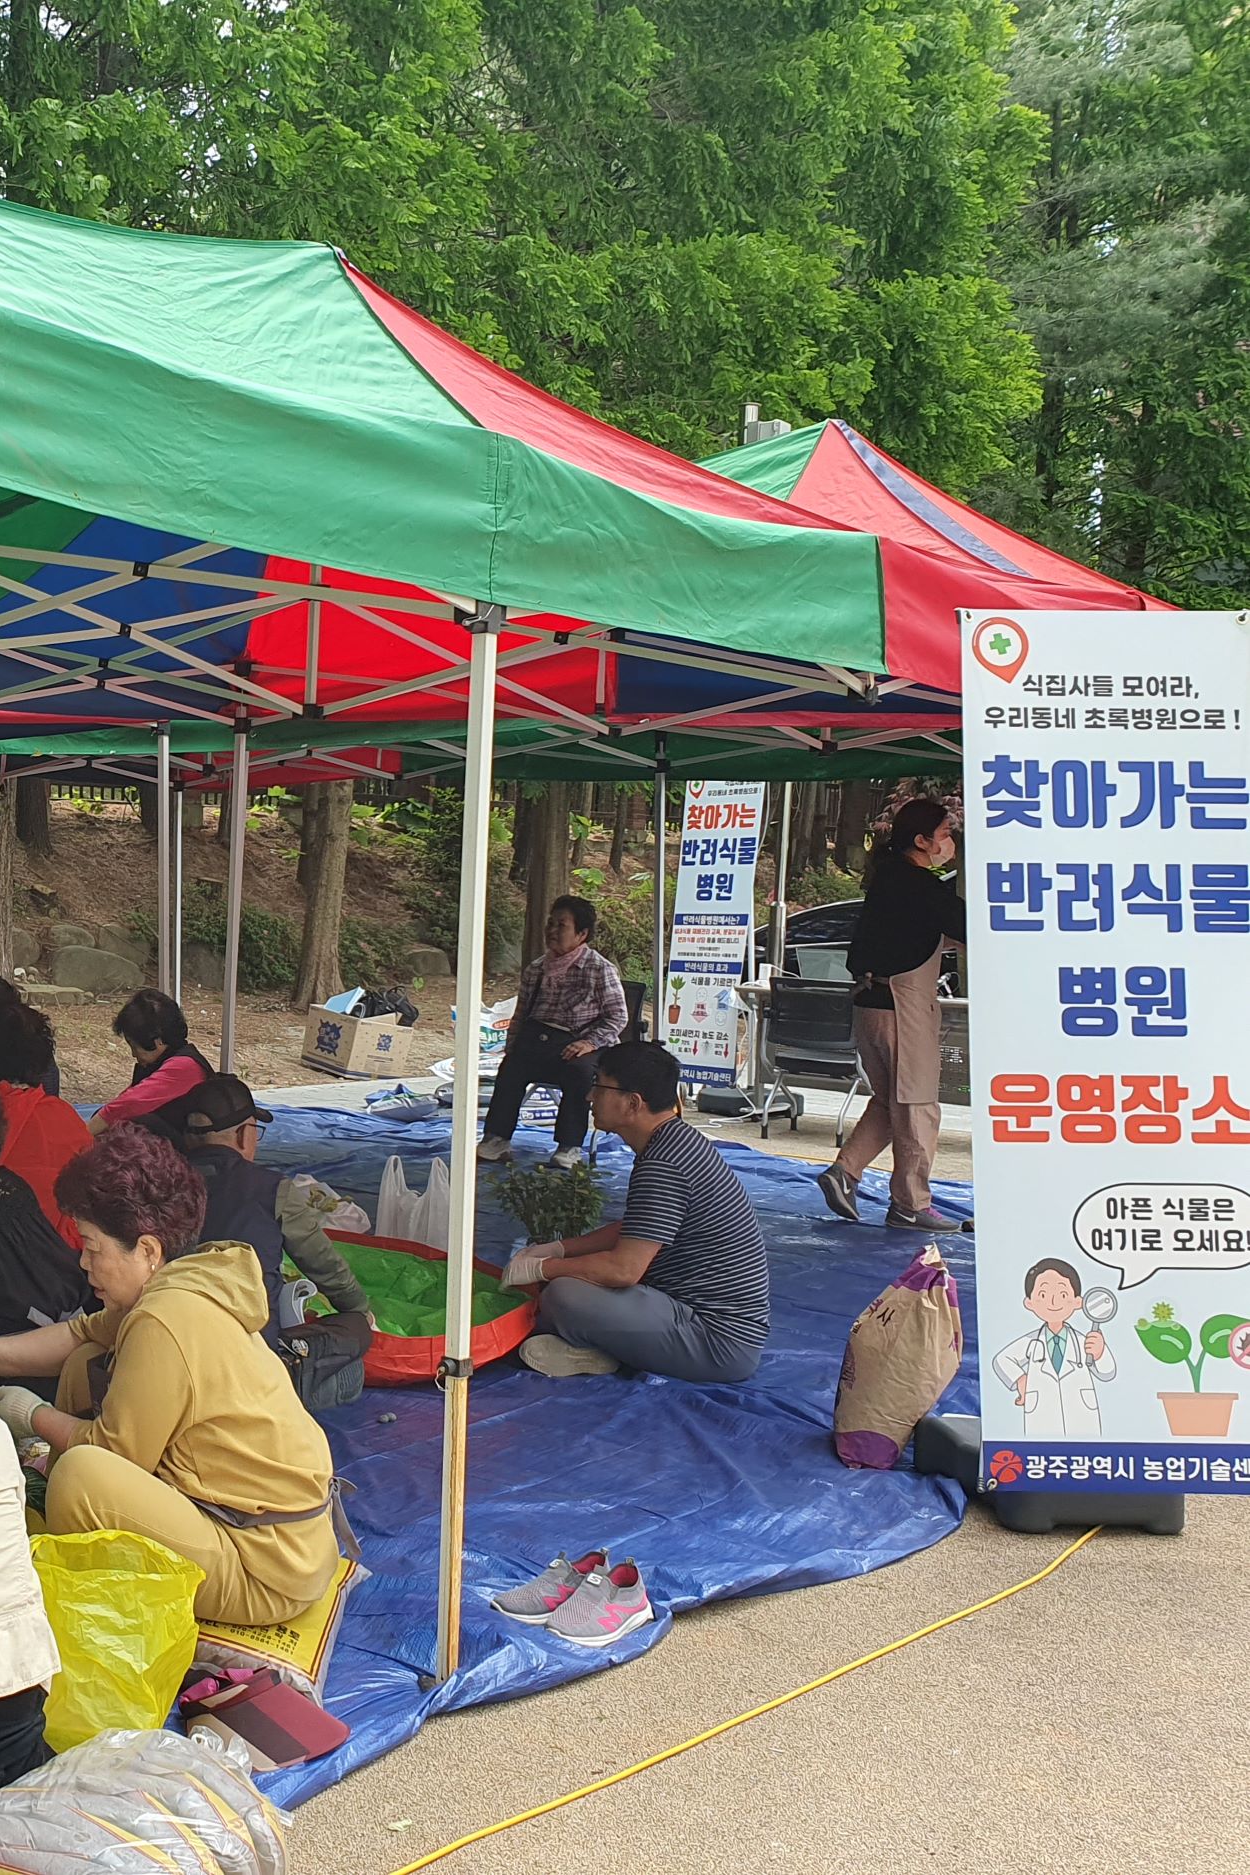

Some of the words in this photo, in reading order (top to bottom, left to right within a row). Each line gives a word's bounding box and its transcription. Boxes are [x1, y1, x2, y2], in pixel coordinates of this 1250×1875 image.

[1022, 674, 1114, 697] 식집사들
[1122, 675, 1200, 699] 모여라,
[984, 706, 1076, 729] 우리동네
[1084, 708, 1226, 730] 초록병원으로
[982, 755, 1250, 830] 찾아가는
[687, 803, 756, 831] 찾아가는
[681, 837, 757, 866] 반려식물
[696, 873, 734, 901] 병원
[986, 862, 1250, 934] 반려식물
[1058, 966, 1188, 1037] 병원
[988, 1074, 1250, 1144] 운영장소
[1106, 1197, 1153, 1221] 아픈
[1162, 1198, 1236, 1222] 식물은
[1091, 1228, 1163, 1252] 여기로
[1025, 1456, 1134, 1480] 광주광역시
